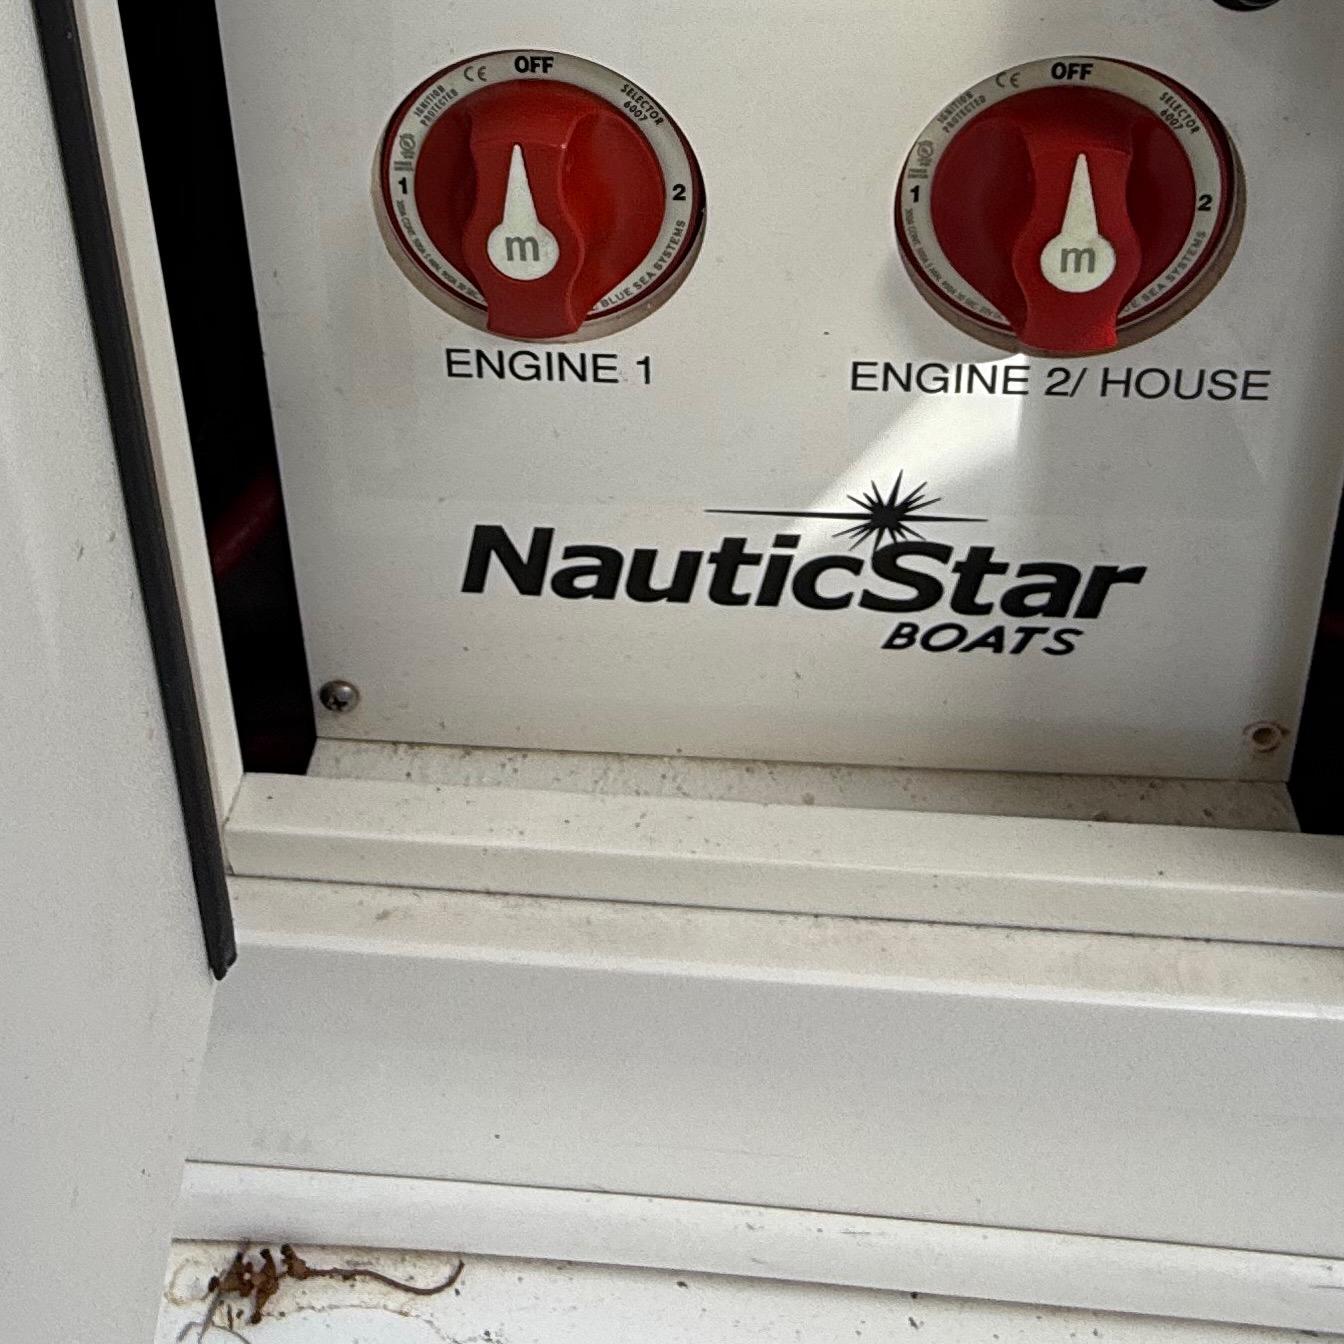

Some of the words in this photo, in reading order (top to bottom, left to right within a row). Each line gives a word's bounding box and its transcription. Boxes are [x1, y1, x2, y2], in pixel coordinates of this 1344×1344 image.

[513, 55, 555, 74] OFF
[1050, 60, 1094, 81] OFF
[620, 82, 665, 126] SELECTOR
[1159, 91, 1202, 135] SELECTOR
[398, 176, 408, 194] 1
[672, 183, 687, 201] 2
[910, 184, 920, 203] 1
[1197, 193, 1213, 212] 2
[505, 234, 540, 262] m
[632, 270, 657, 291] SEA
[655, 219, 687, 272] SYSTEMS
[1060, 247, 1097, 274] m
[444, 347, 619, 384] ENGINE
[635, 354, 653, 385] 1
[850, 360, 1031, 396] ENGINE
[1045, 365, 1089, 400] 2/
[1100, 365, 1273, 401] HOUSE
[460, 521, 1148, 621] NauticStar
[881, 620, 1086, 657] BOATS
